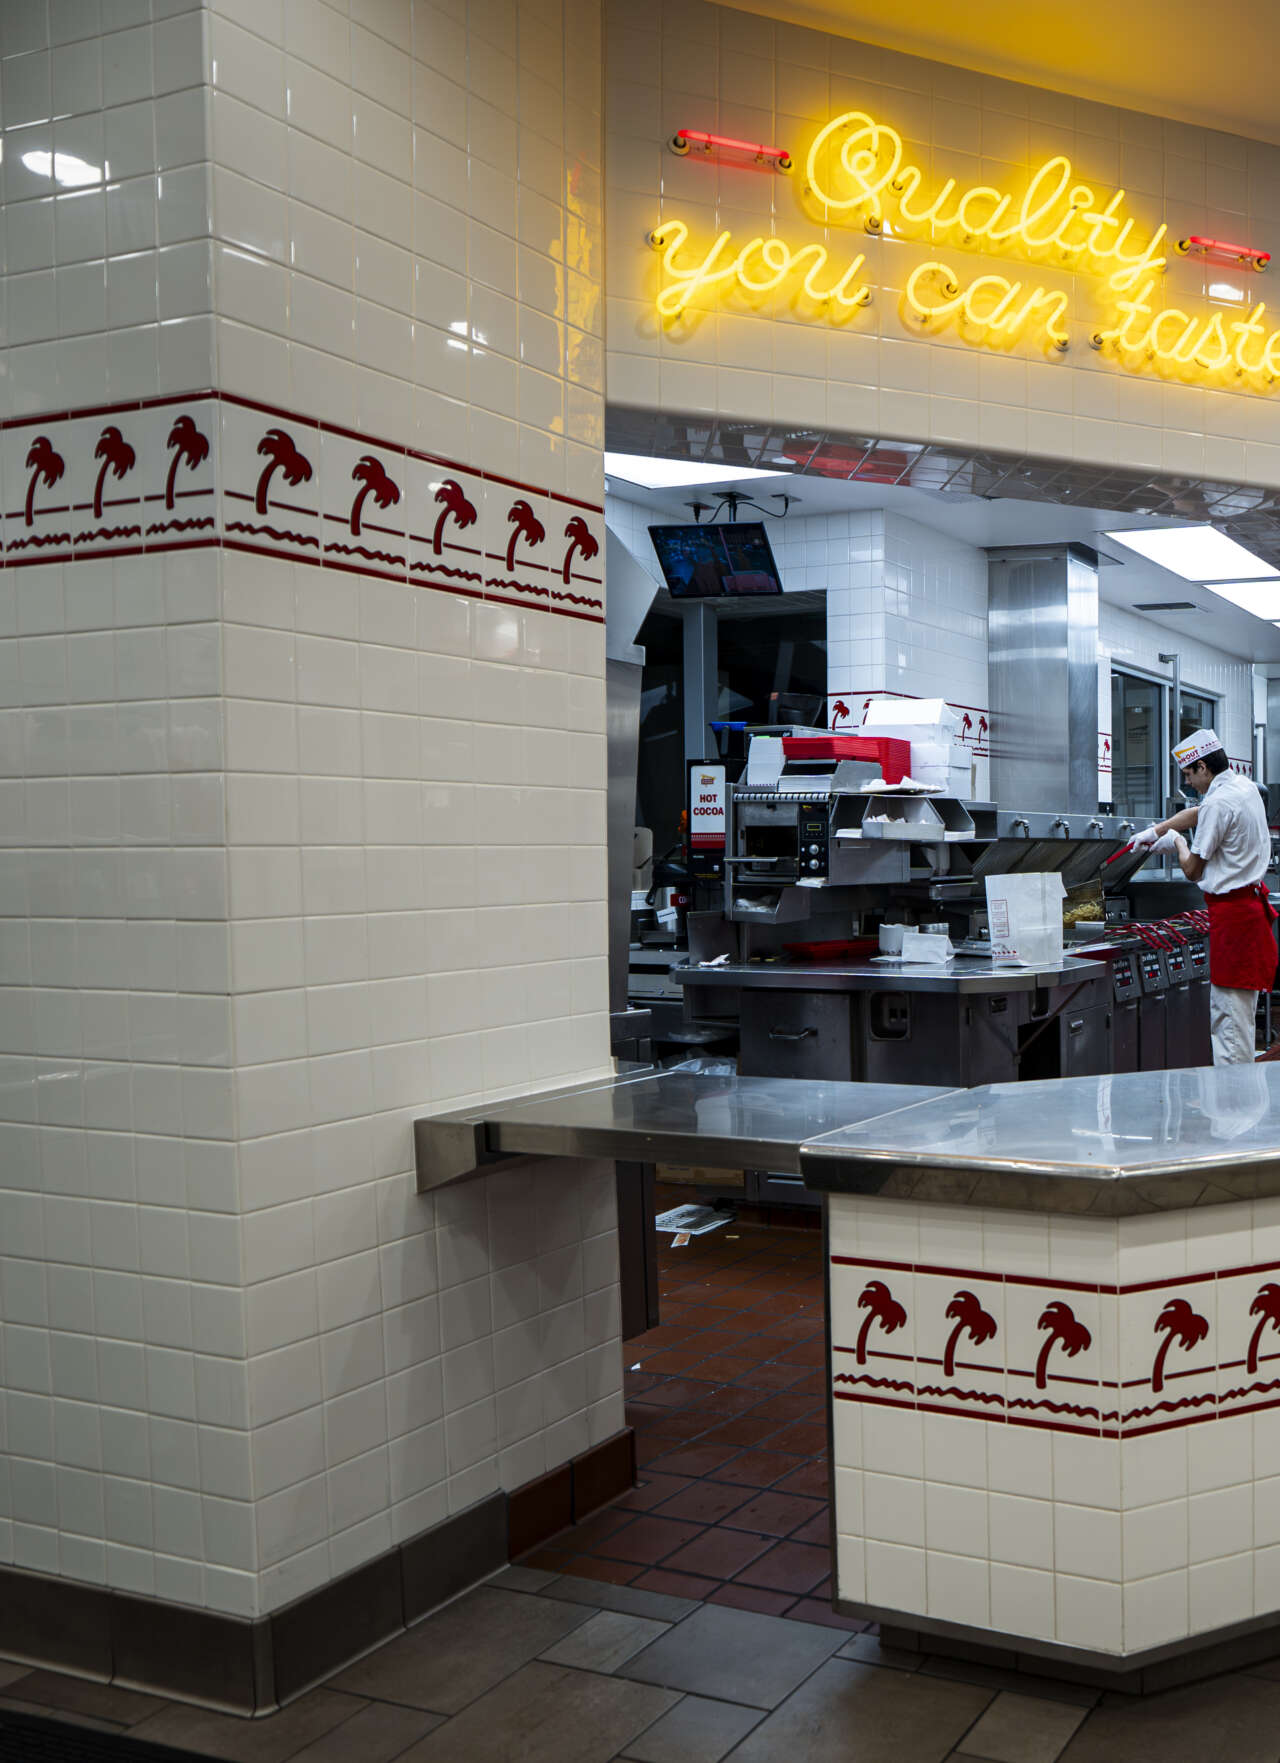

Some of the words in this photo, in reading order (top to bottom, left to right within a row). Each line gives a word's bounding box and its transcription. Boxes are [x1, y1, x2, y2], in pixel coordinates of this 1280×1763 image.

[807, 112, 1167, 290] Quality
[653, 220, 870, 316] you
[906, 261, 1069, 341] can
[693, 807, 724, 816] COCOA
[699, 794, 718, 803] HOT
